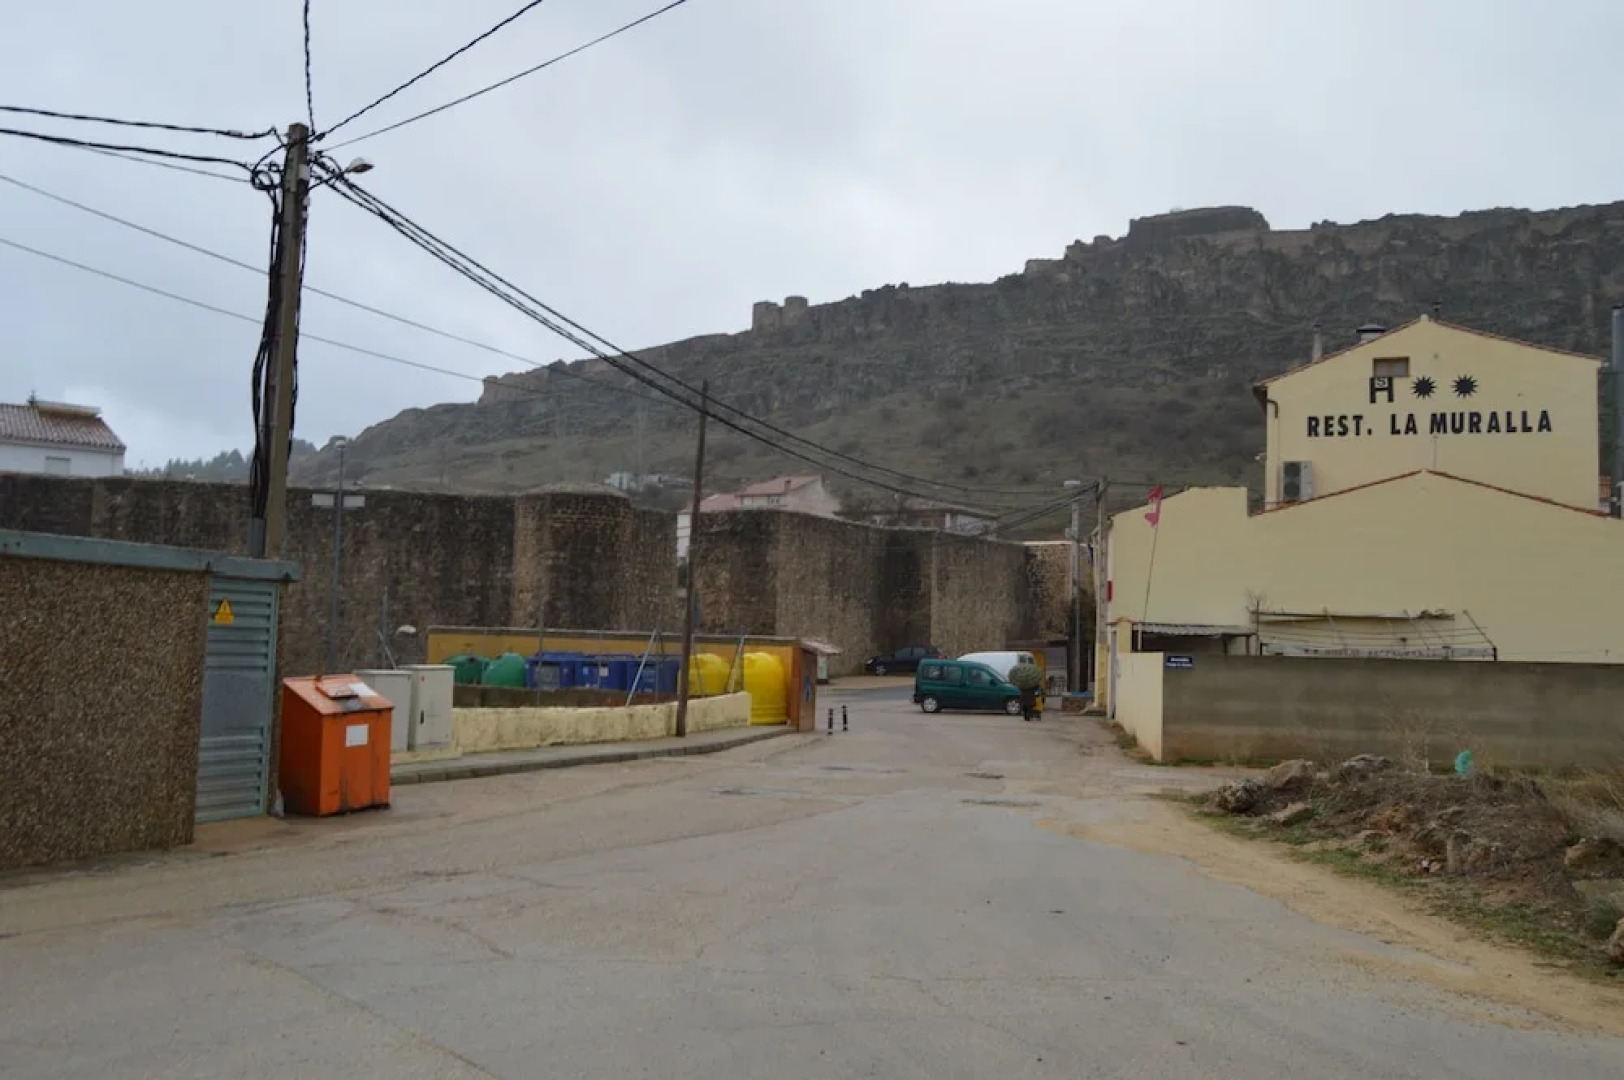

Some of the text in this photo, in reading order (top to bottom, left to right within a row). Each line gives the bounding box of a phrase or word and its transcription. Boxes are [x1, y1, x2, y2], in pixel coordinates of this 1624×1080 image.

[1307, 409, 1553, 438] REST. LA MURALLA
